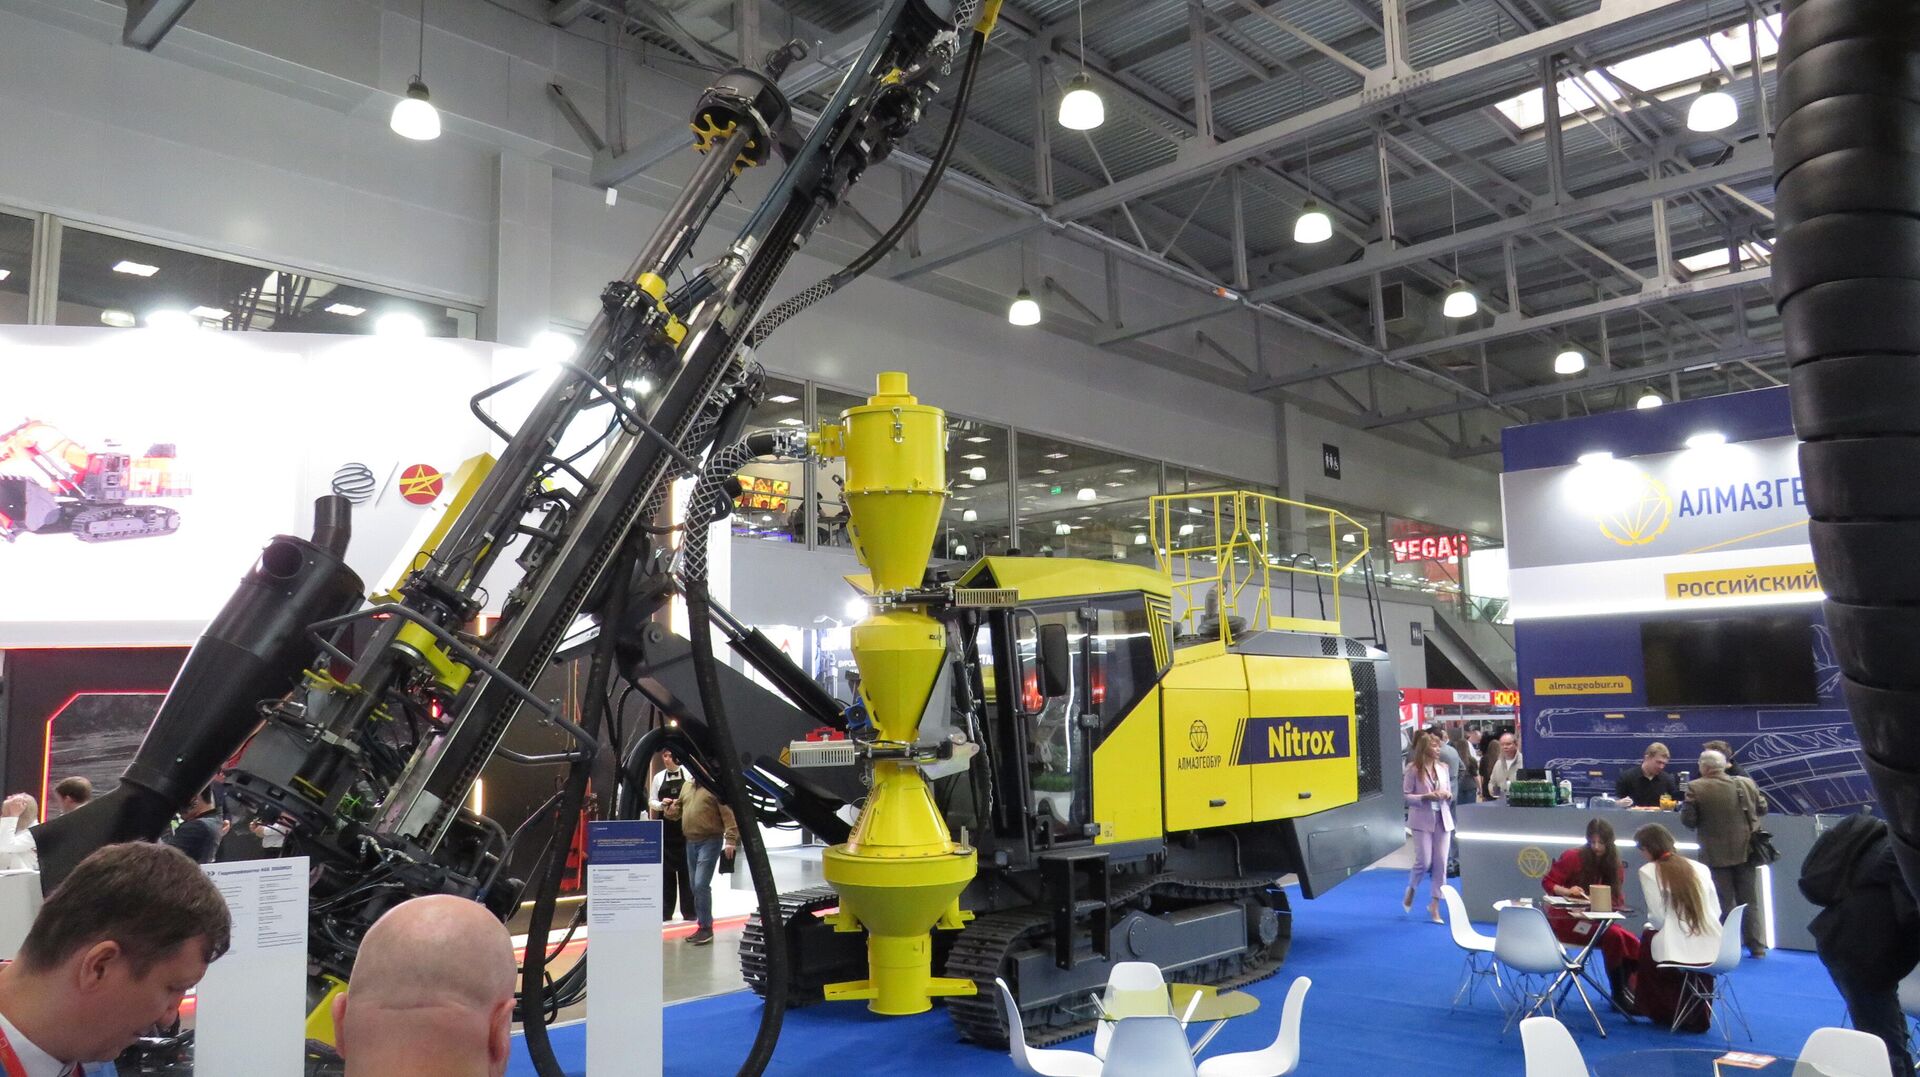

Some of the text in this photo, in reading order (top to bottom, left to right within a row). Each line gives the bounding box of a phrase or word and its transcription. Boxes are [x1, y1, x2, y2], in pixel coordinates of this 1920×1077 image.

[1392, 534, 1468, 562] VEGAS
[1677, 570, 1819, 598] РОССИЙСКИЙ
[1548, 680, 1625, 691] almazgeobur.ru
[1268, 721, 1335, 759] Nitrox
[1177, 755, 1222, 770] АЛМАЗГЕОБУР
